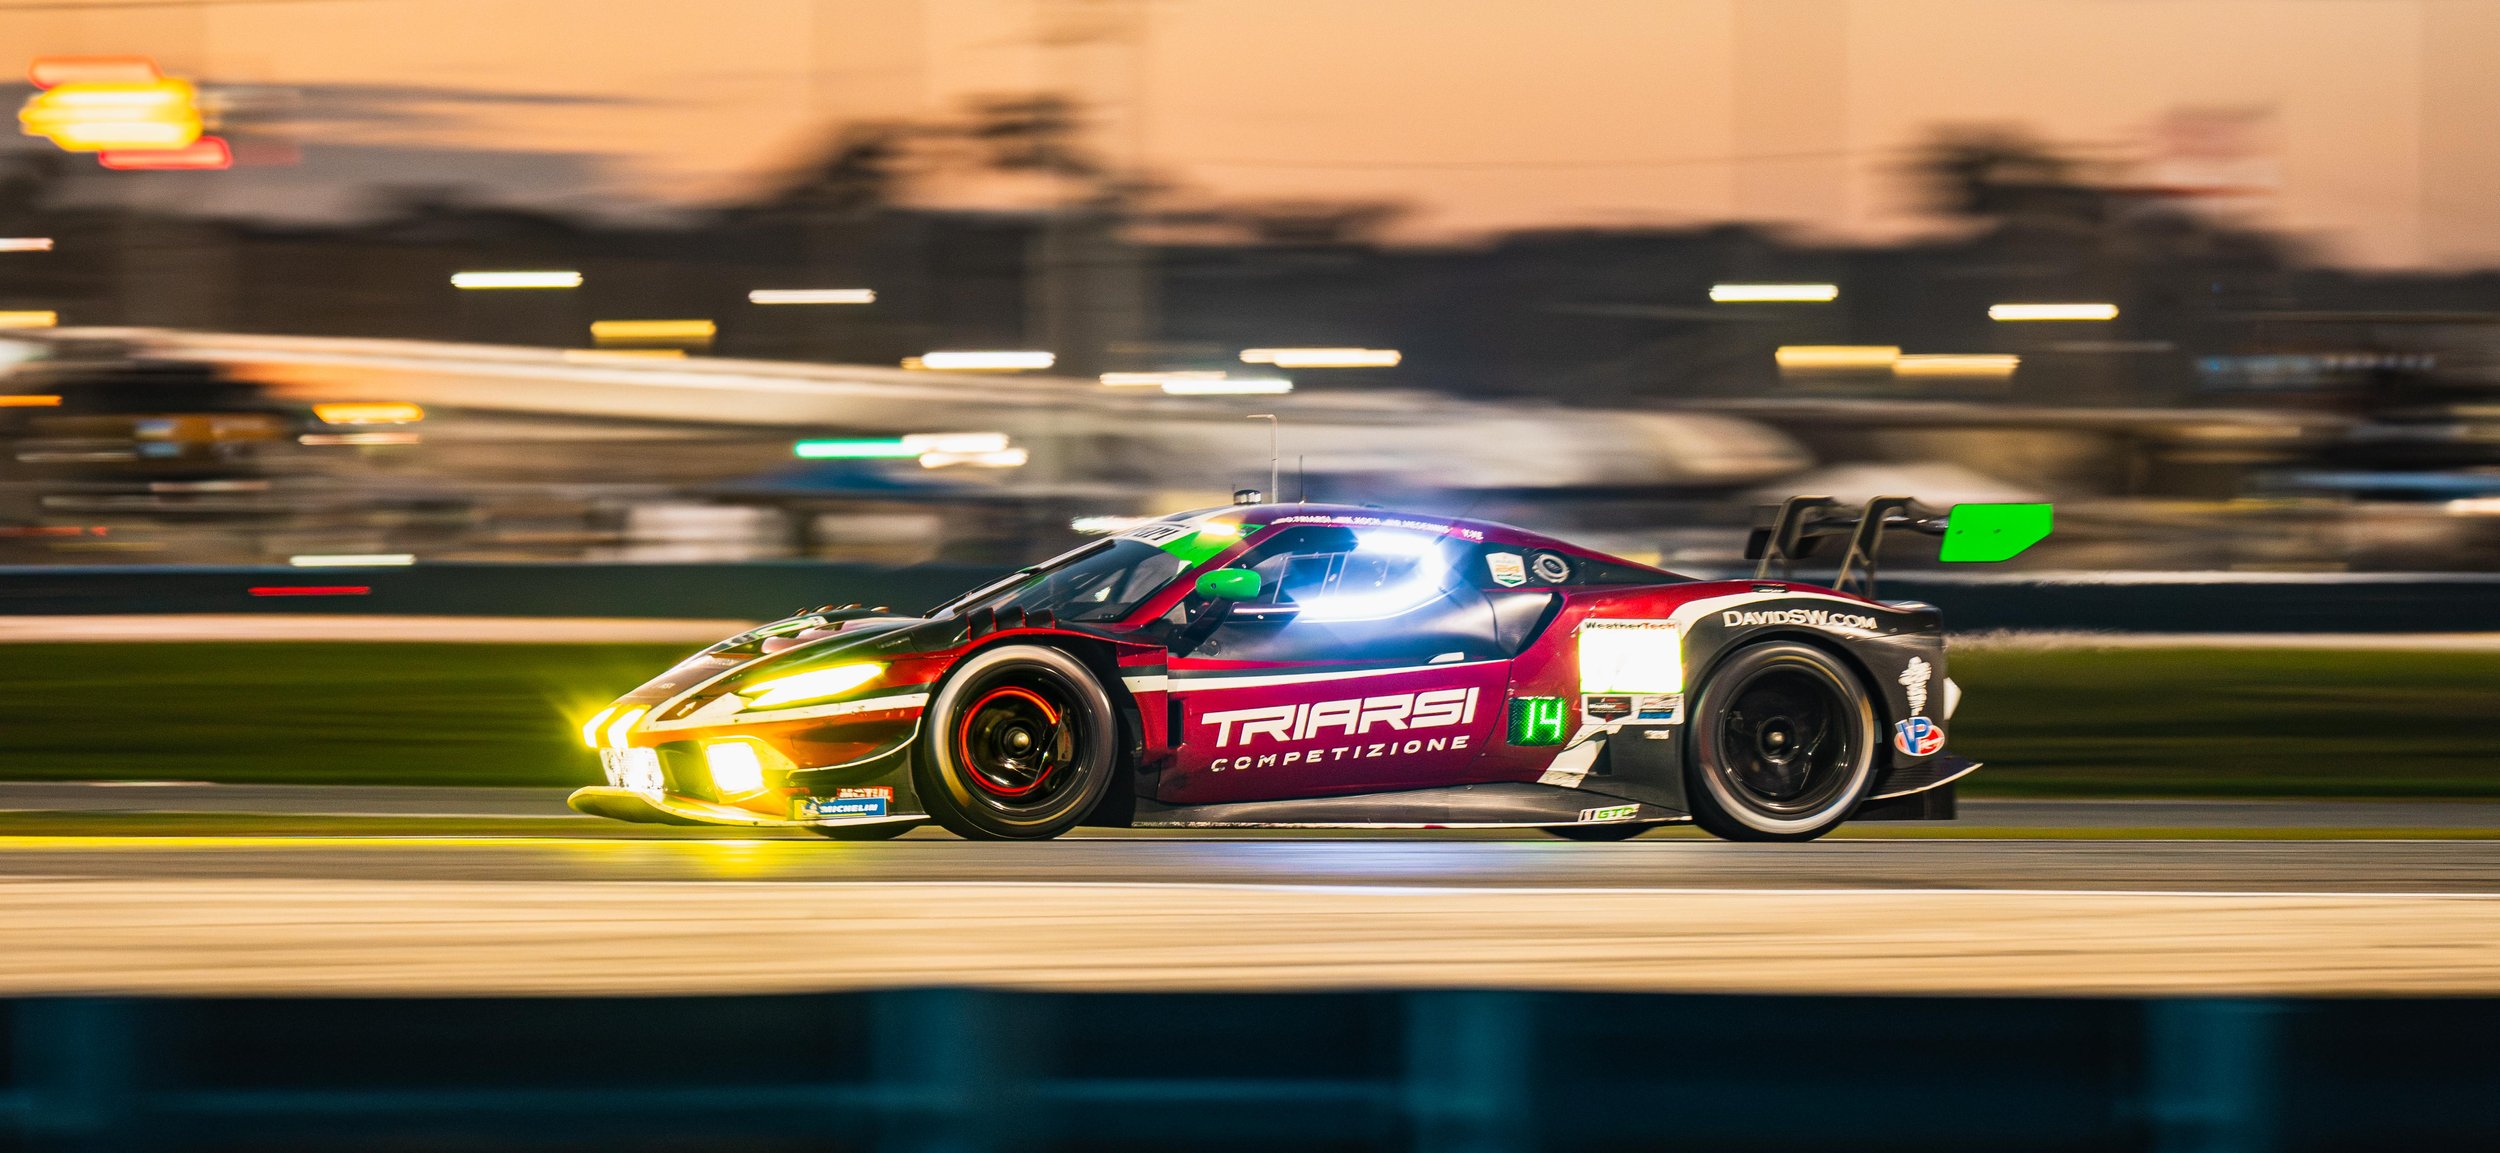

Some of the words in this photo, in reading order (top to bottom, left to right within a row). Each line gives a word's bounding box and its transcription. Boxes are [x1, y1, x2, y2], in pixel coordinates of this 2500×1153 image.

[1201, 686, 1480, 747] TRIARSI
[1526, 701, 1563, 739] 14
[1894, 716, 1933, 754] VP
[1210, 735, 1471, 772] COMPETIZIONE
[818, 803, 879, 813] MICHELIN
